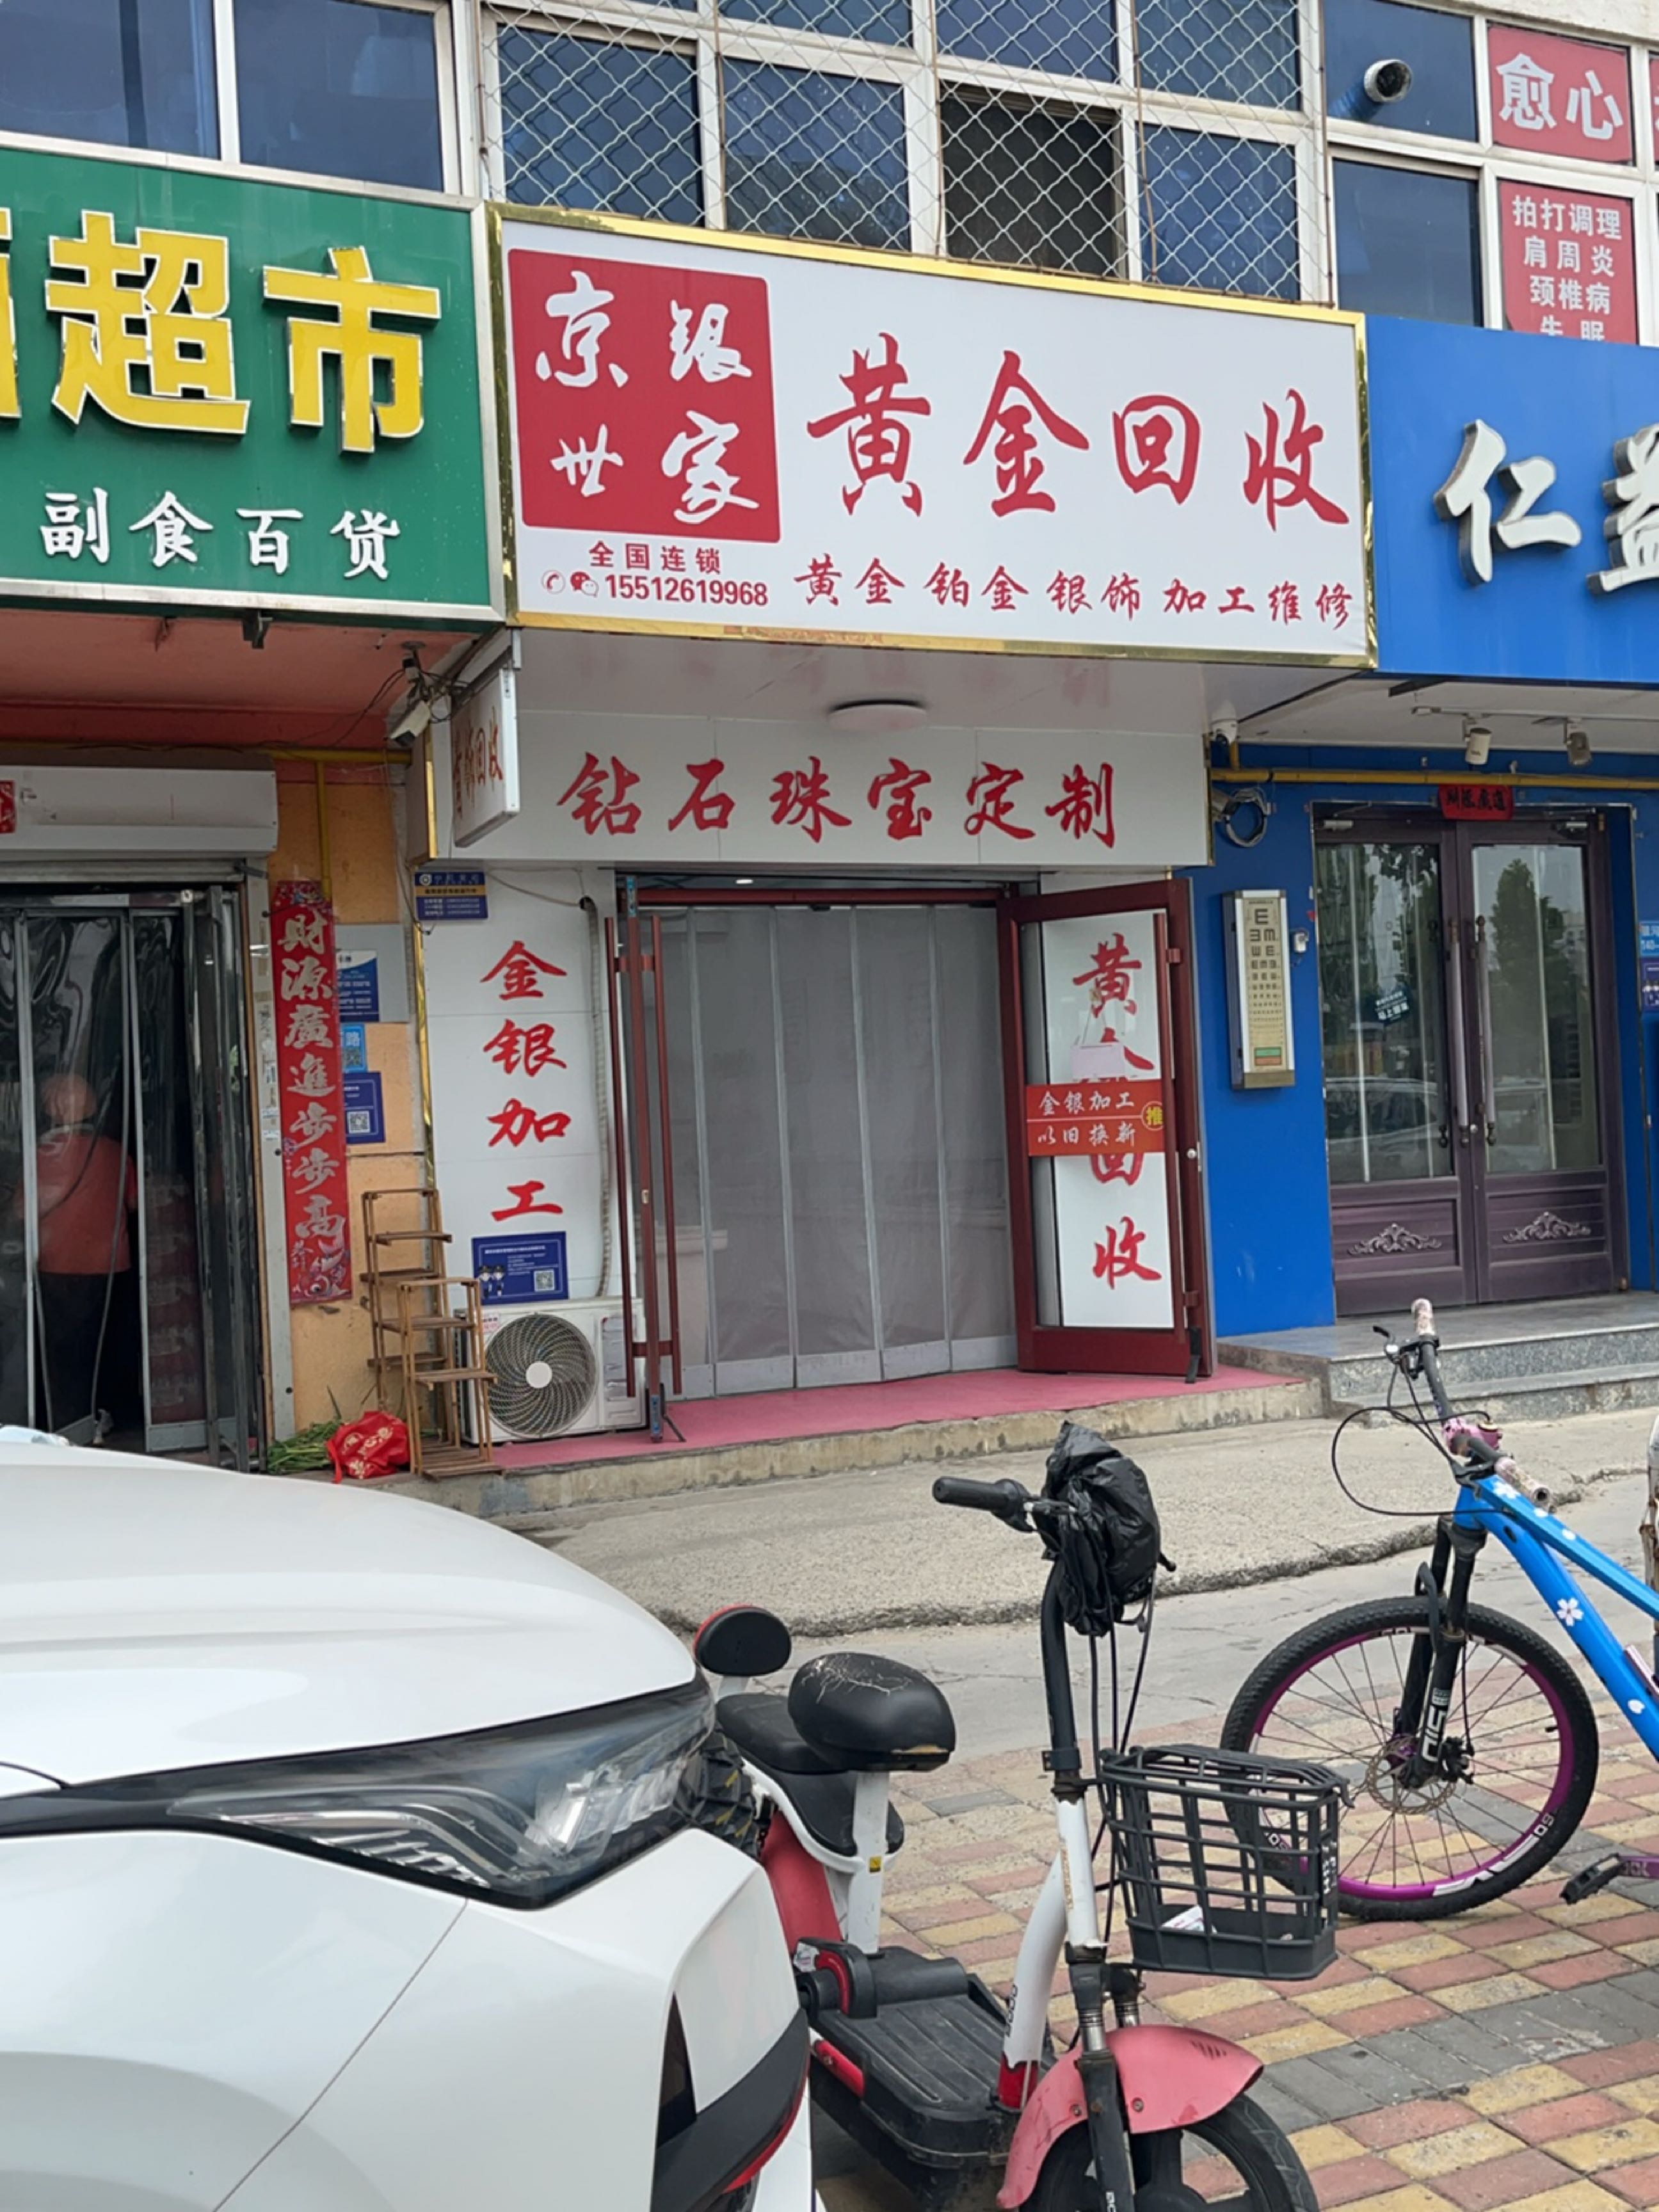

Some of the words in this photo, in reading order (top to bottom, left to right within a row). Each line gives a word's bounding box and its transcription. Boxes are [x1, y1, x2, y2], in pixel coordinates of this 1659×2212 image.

[1496, 53, 1624, 140] 愈心
[1512, 195, 1623, 240] 拍打调理
[1523, 236, 1615, 277] 肩周炎
[1529, 275, 1611, 314] 颈椎病
[0, 208, 442, 453] 超市
[806, 332, 1350, 531] 黄金回收
[40, 488, 400, 580] 副食百货
[588, 540, 721, 574] 全国连锁
[605, 573, 769, 607] 15512619968
[556, 751, 1116, 849] 钻石珠宝定制
[480, 940, 572, 1222] 金银加工
[1038, 1090, 1135, 1116] 金银加工
[1038, 1121, 1137, 1147] 以旧换新
